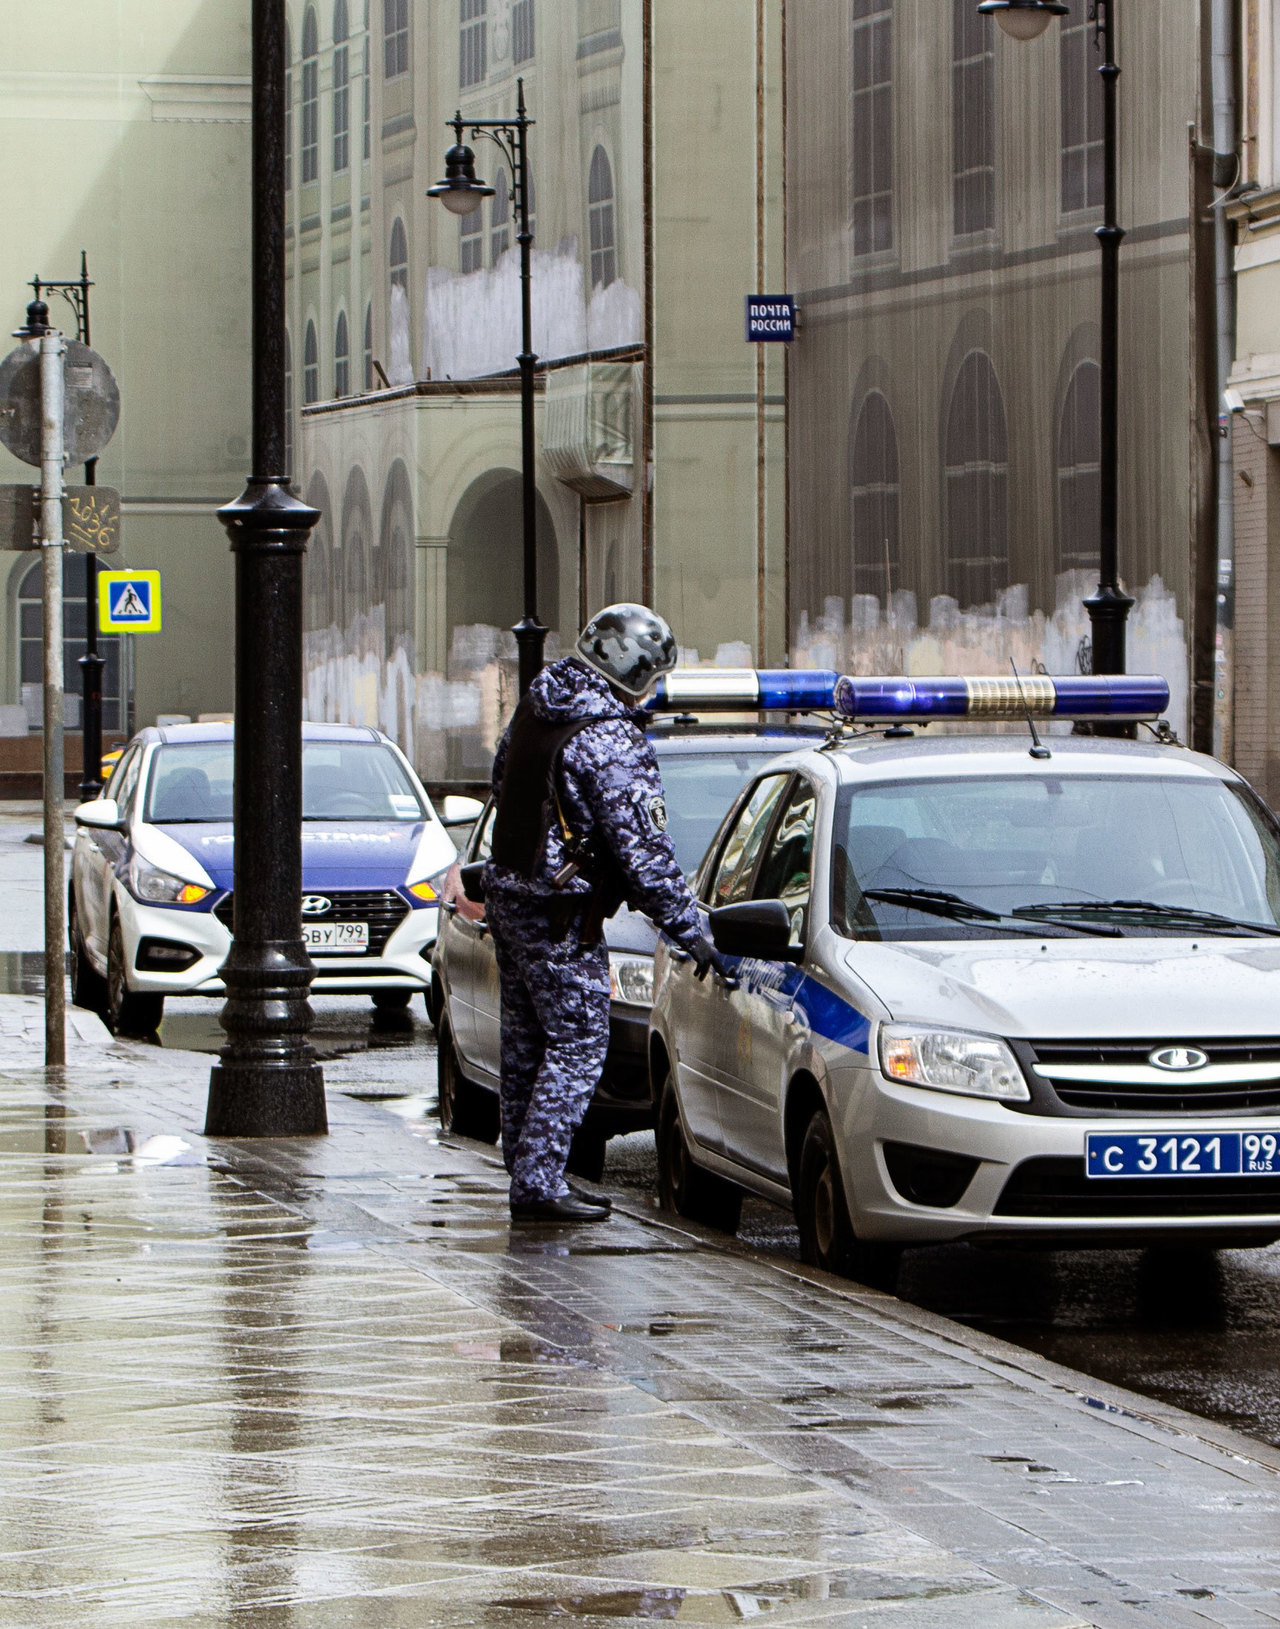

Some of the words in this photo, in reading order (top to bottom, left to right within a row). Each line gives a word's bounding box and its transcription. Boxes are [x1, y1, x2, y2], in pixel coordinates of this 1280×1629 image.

[751, 304, 791, 317] ПОЧТА
[751, 319, 792, 331] РОССИИ
[338, 924, 363, 938] 799
[1137, 1137, 1221, 1172] 3121
[1245, 1134, 1278, 1160] 99
[1250, 1160, 1274, 1171] RUS
